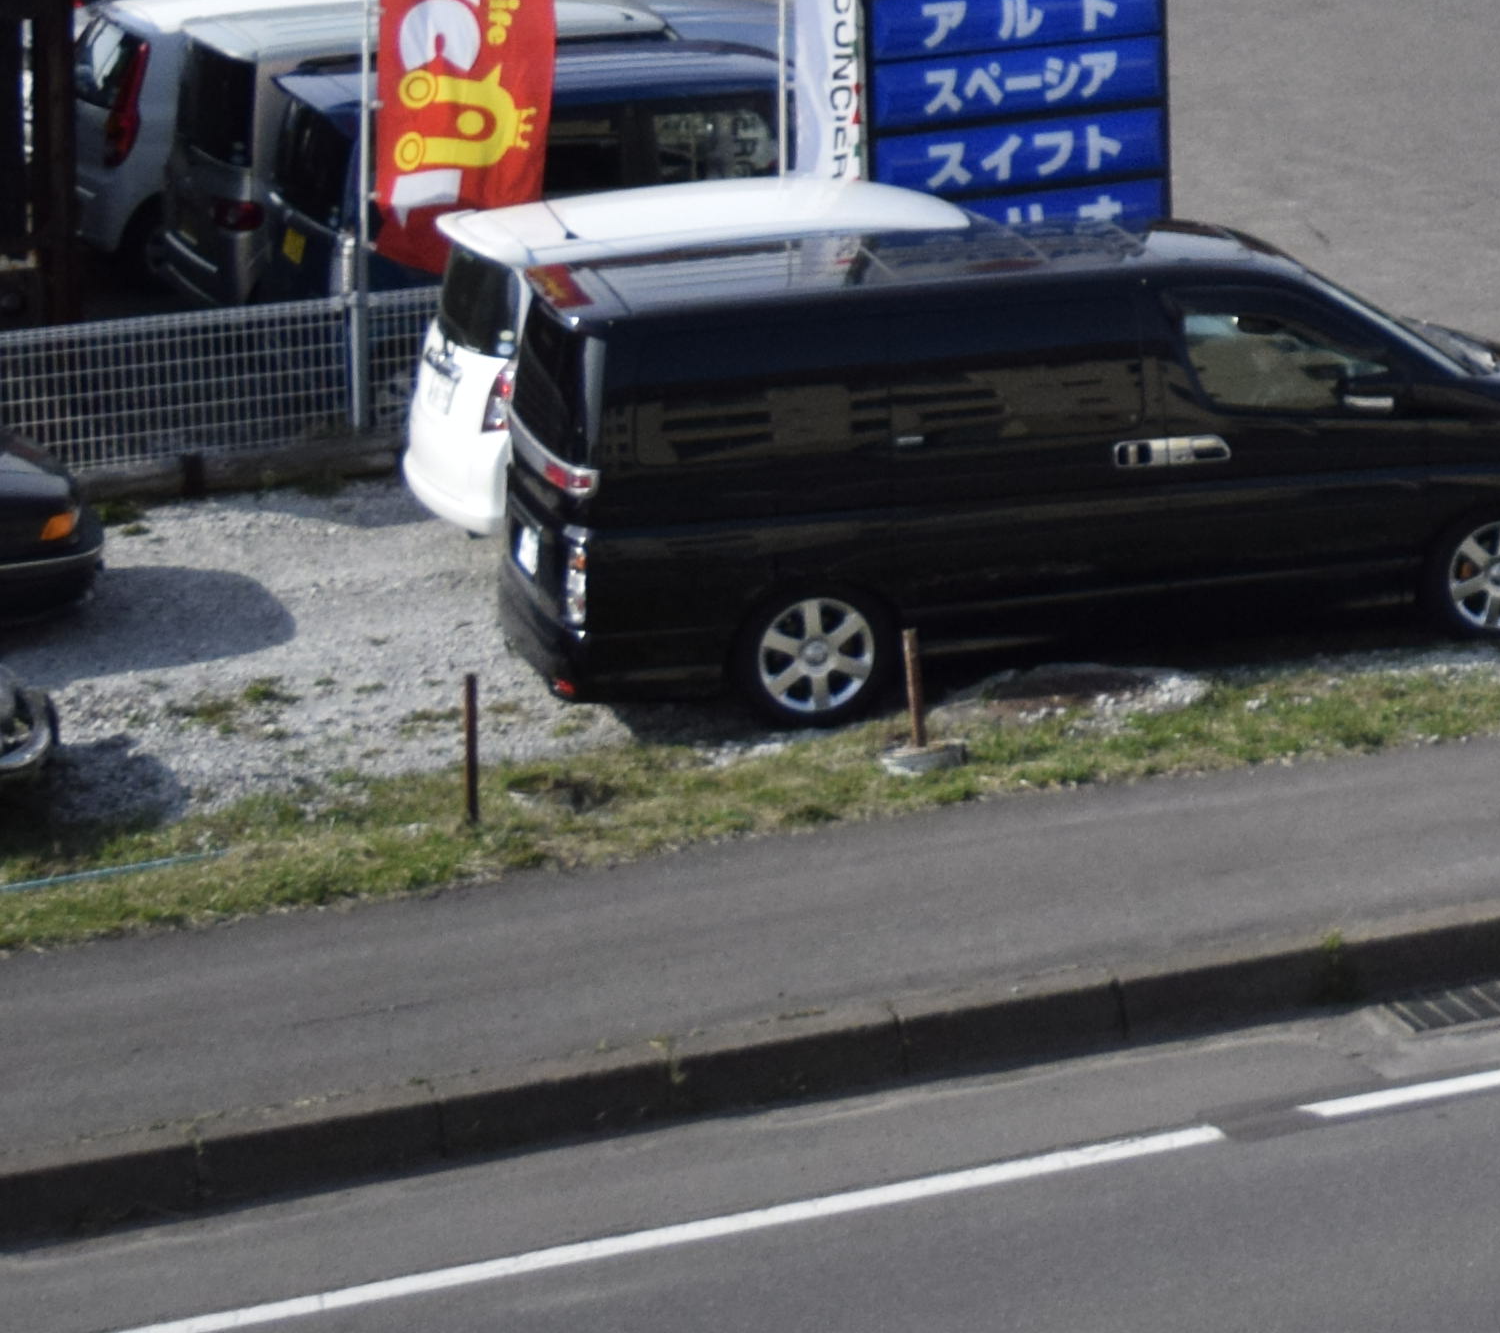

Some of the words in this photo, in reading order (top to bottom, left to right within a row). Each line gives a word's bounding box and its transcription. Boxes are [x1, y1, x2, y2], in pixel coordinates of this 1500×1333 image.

[924, 50, 1118, 116] スペーシア
[927, 124, 1123, 189] スイフト
